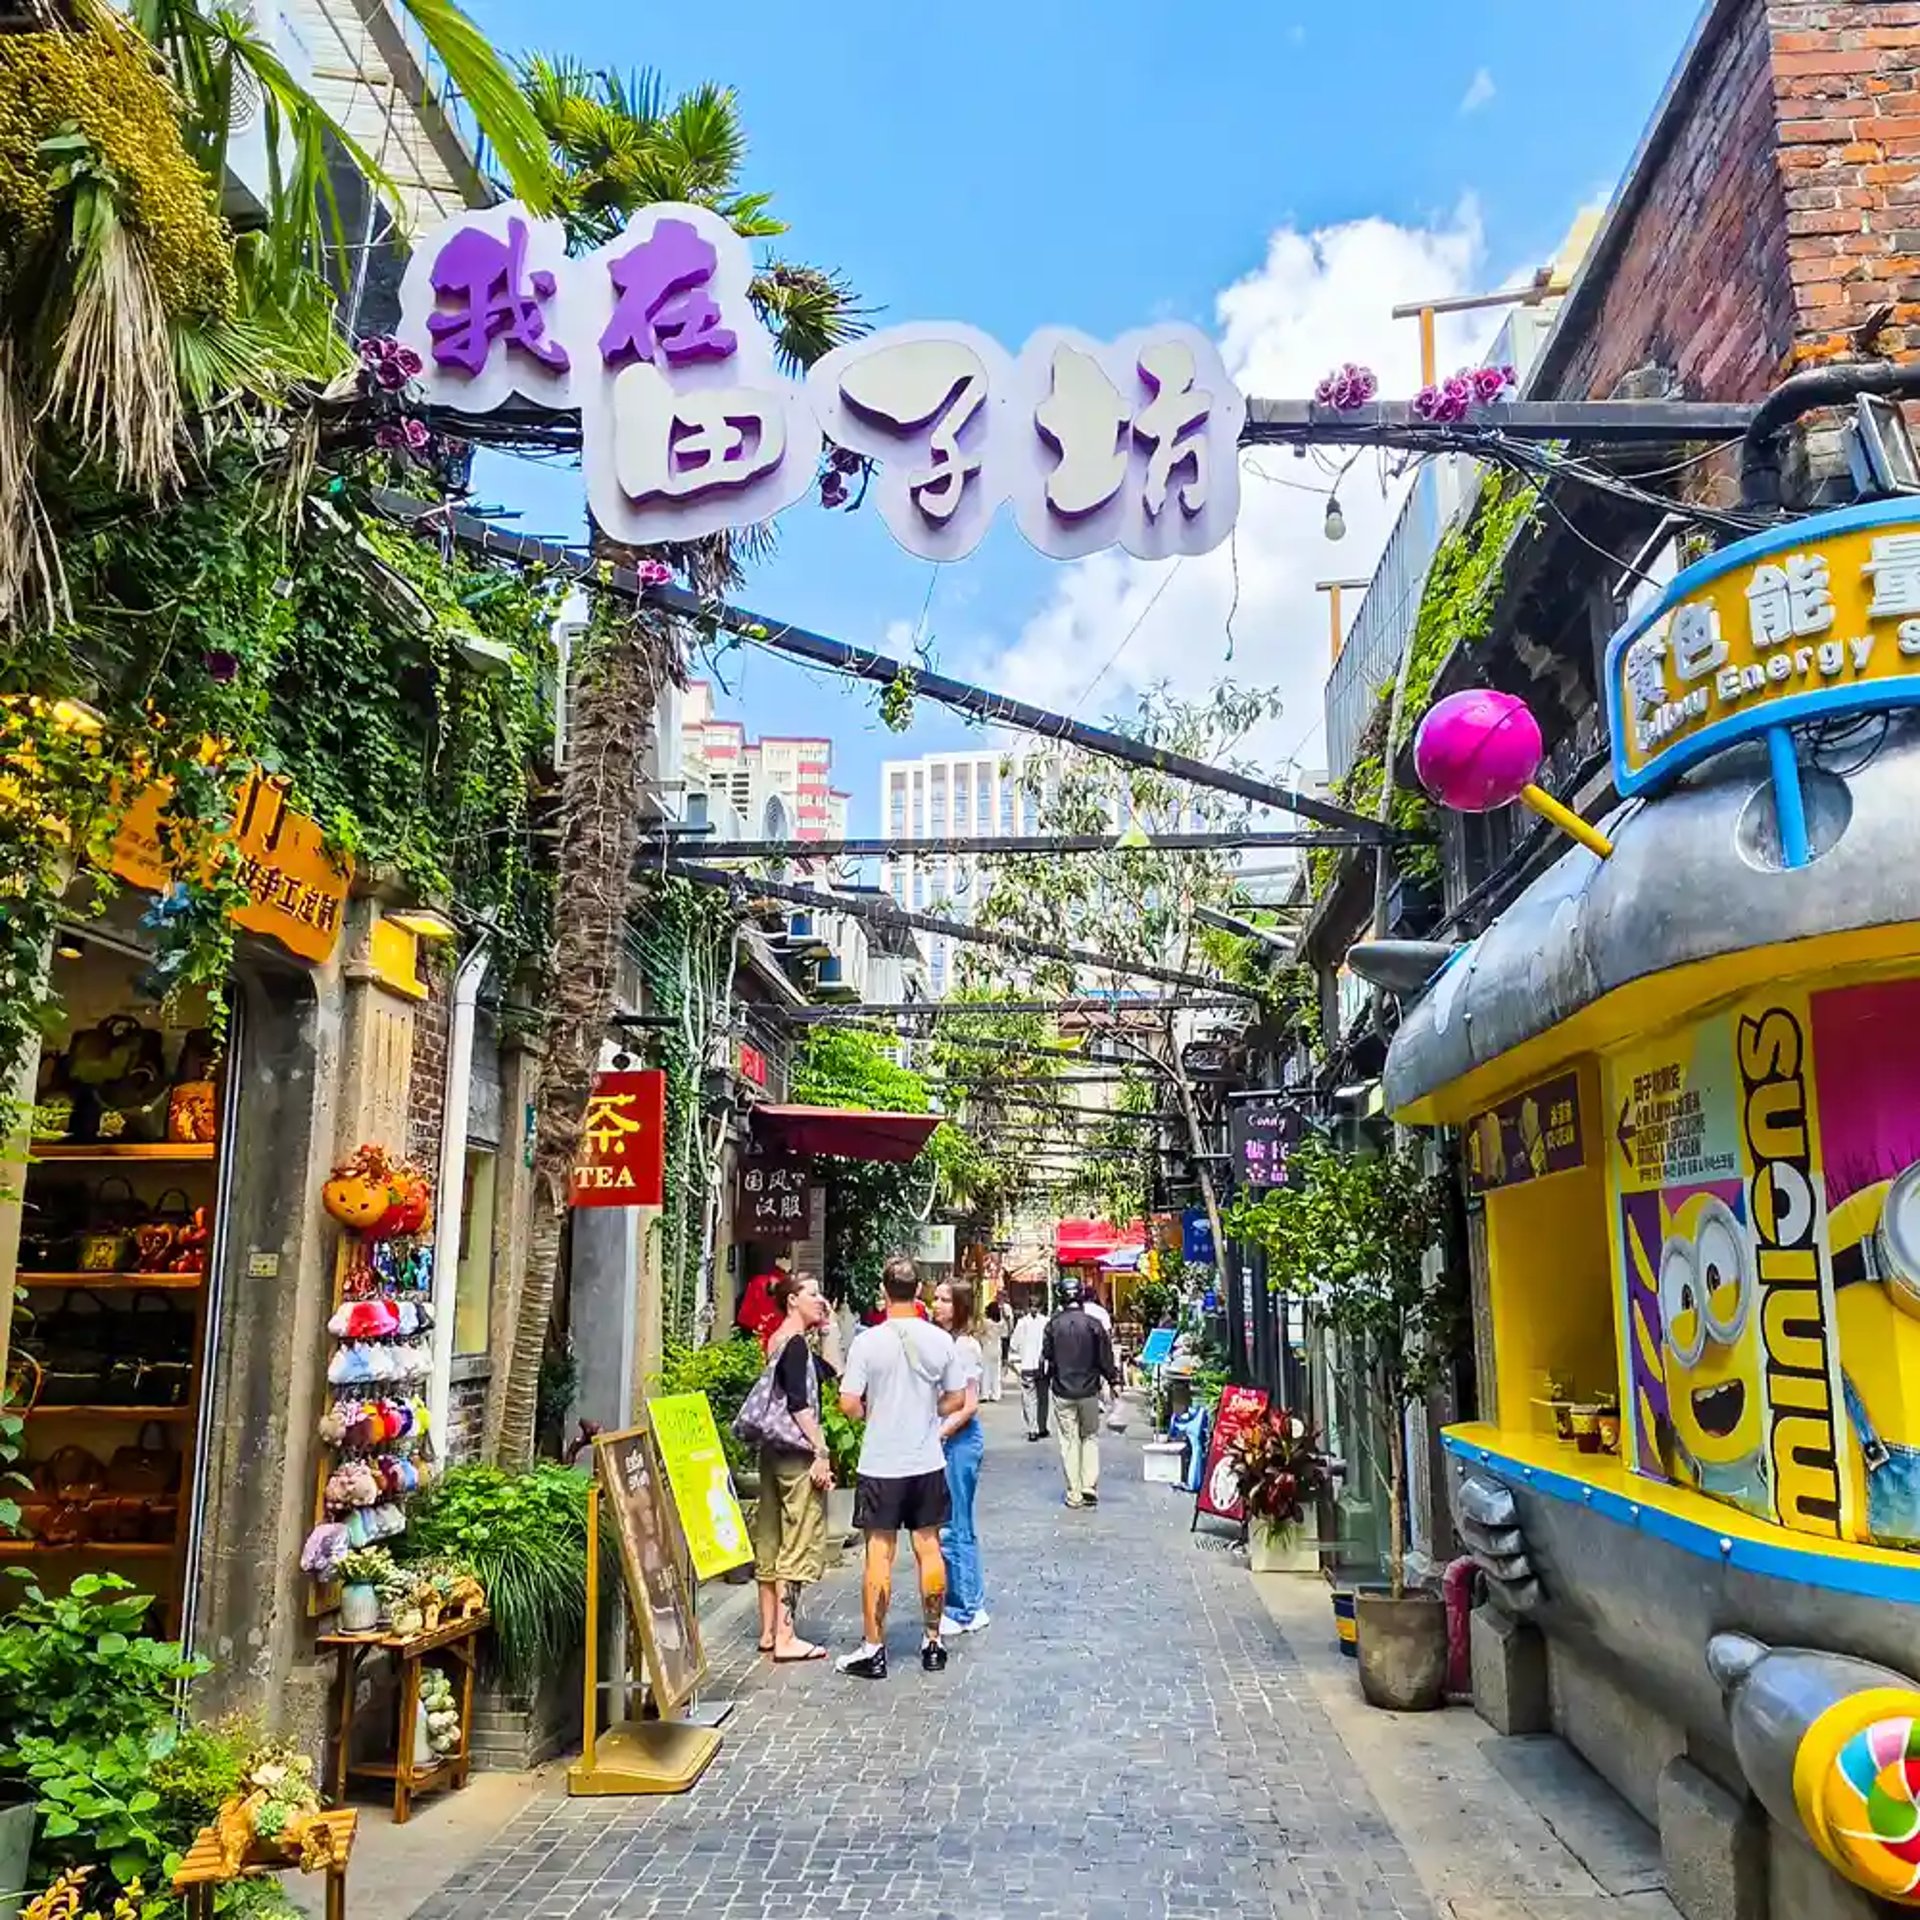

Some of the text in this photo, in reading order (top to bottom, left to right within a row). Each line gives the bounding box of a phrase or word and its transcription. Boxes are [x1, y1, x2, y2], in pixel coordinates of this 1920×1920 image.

[426, 216, 738, 378] 我在
[614, 338, 1218, 530] 田子坊
[1715, 634, 1875, 702] Energy
[584, 1092, 641, 1154] 茶
[573, 1165, 637, 1189] TEA
[744, 1168, 793, 1191] 国风
[755, 1194, 803, 1219] 汉服
